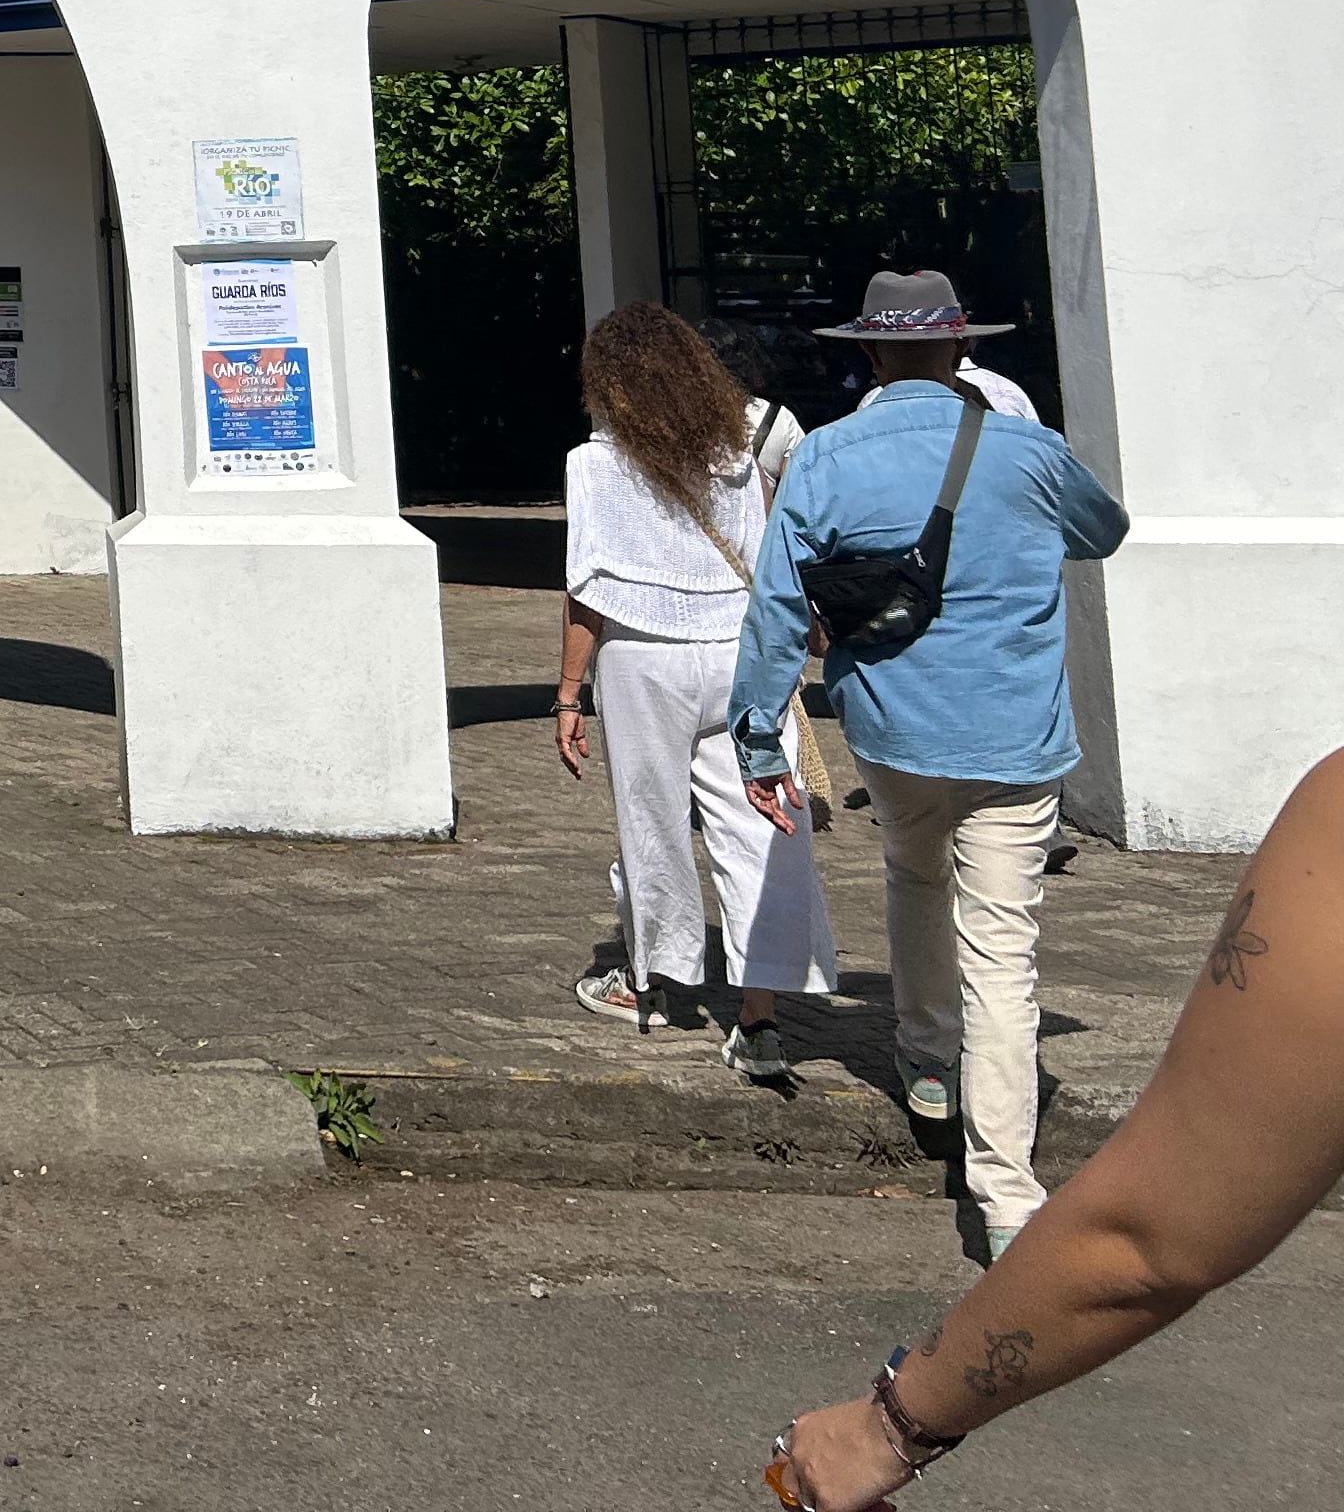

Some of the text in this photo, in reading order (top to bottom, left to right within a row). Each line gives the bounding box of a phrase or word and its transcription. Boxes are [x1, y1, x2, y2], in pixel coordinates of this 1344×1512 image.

[220, 208, 282, 219] 19 DE ABRIL
[212, 281, 287, 299] GUARDA RÍOS
[212, 361, 253, 379] CANTO
[266, 360, 301, 376] AGUA
